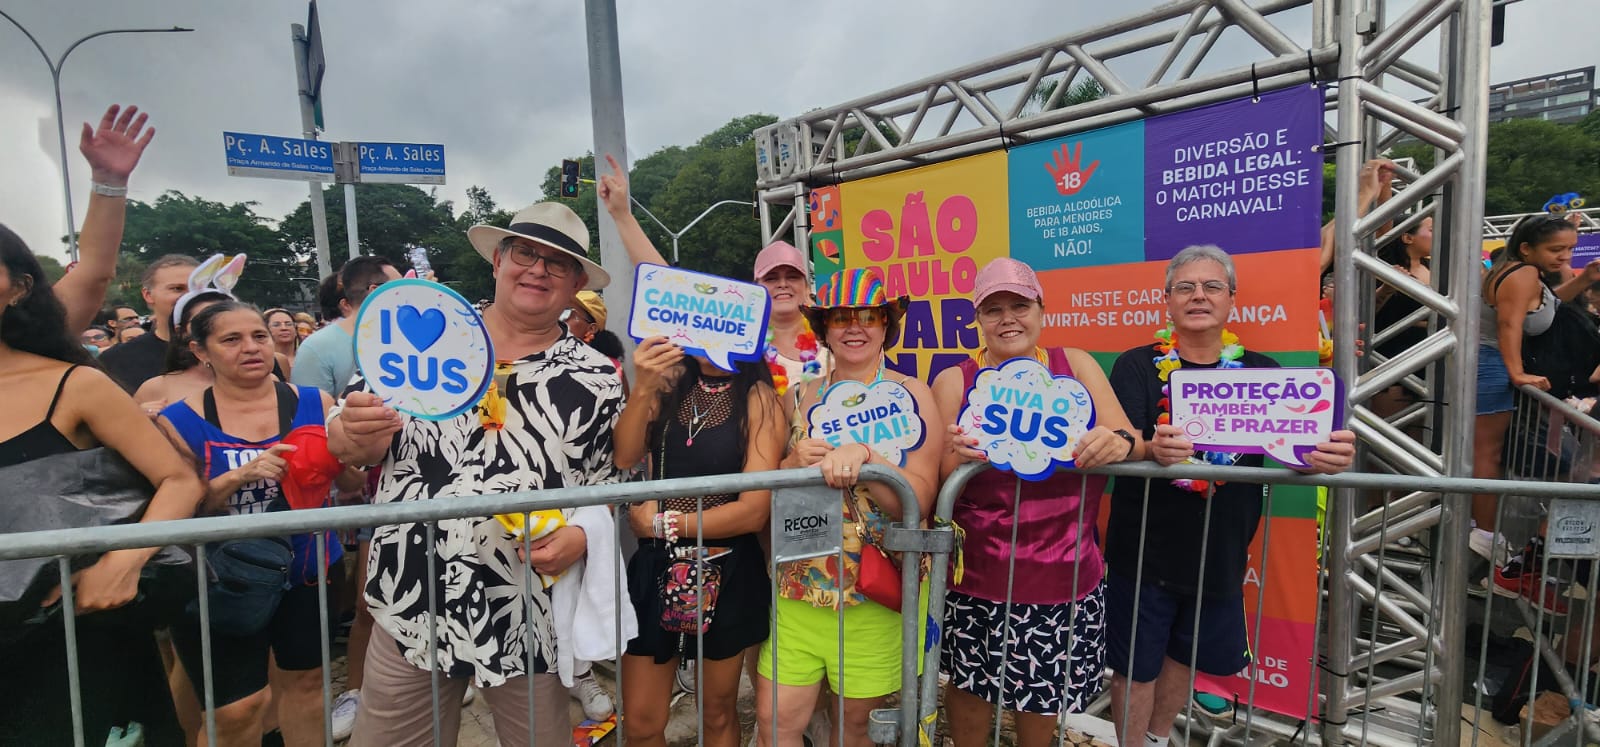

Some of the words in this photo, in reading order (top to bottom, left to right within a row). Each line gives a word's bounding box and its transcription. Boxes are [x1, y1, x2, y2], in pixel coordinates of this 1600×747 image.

[225, 135, 252, 156] Pç.
[260, 138, 276, 154] A.
[282, 140, 328, 159] Sales
[360, 145, 379, 163] Pç.
[385, 146, 398, 160] A.
[403, 146, 440, 161] Sales
[1174, 132, 1269, 164] DIVERSÃO
[1276, 128, 1288, 146] E
[1162, 161, 1229, 185] BEBIDA
[1234, 149, 1302, 174] LEGAL:
[1156, 190, 1167, 205] O
[1172, 180, 1236, 204] MATCH
[1242, 168, 1310, 194] DESSE
[1026, 204, 1062, 218] BEBIDA
[1064, 195, 1122, 213] ALCOÓLICA
[1034, 216, 1060, 229] PARA
[1062, 209, 1113, 224] MENORES
[1176, 194, 1283, 222] CARNAVAL!
[861, 191, 978, 262] SÃO
[1043, 228, 1056, 239] DE
[1059, 227, 1069, 237] 18
[1071, 222, 1104, 235] ANOS,
[1054, 238, 1092, 258] NÃO!
[644, 288, 756, 323] CARNAVAL
[1071, 290, 1123, 307] NESTE
[1127, 288, 1166, 305] CAR
[380, 309, 391, 345] I
[647, 307, 689, 326] COM
[692, 314, 747, 336] SAÚDE
[886, 298, 980, 350] AR
[1042, 311, 1117, 328] IVIRTA-SE
[1122, 309, 1160, 325] COM
[379, 352, 468, 394] SUS
[990, 385, 1044, 411] VIVA
[1052, 397, 1070, 415] O
[1182, 378, 1322, 405] PROTEÇÃO
[821, 418, 843, 435] SE
[846, 402, 902, 427] CUIDA
[1189, 400, 1268, 416] TAMBÉM
[849, 415, 911, 444] VAI!
[981, 404, 1069, 449] SUS
[1214, 414, 1226, 432] É
[1231, 418, 1318, 434] PRAZER
[784, 513, 828, 532] RECON
[1265, 656, 1288, 671] DE
